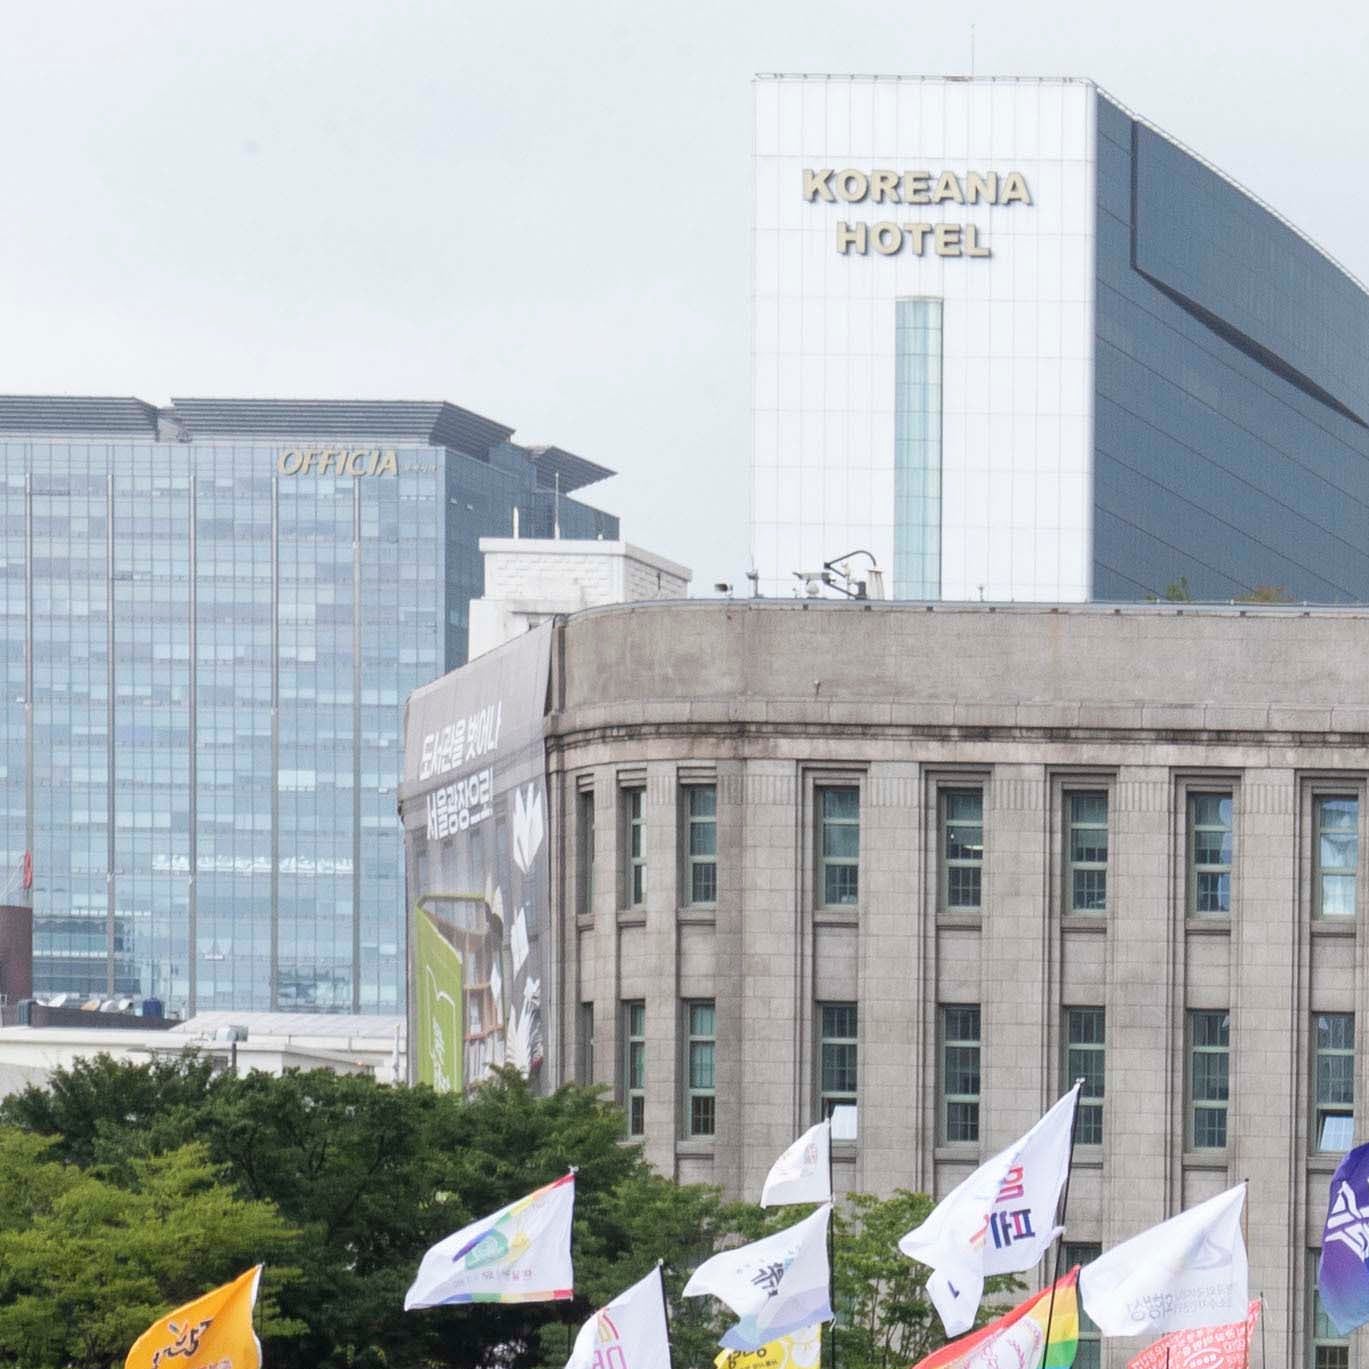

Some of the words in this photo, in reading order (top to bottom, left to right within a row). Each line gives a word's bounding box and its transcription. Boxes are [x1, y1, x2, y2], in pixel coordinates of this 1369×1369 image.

[802, 168, 1034, 206] KOREANA
[835, 221, 992, 258] HOTEL
[276, 449, 400, 477] OFFICIA
[418, 718, 466, 782] 도서관을
[465, 699, 502, 762] 벗어나
[426, 764, 494, 841] 서울광장으로
